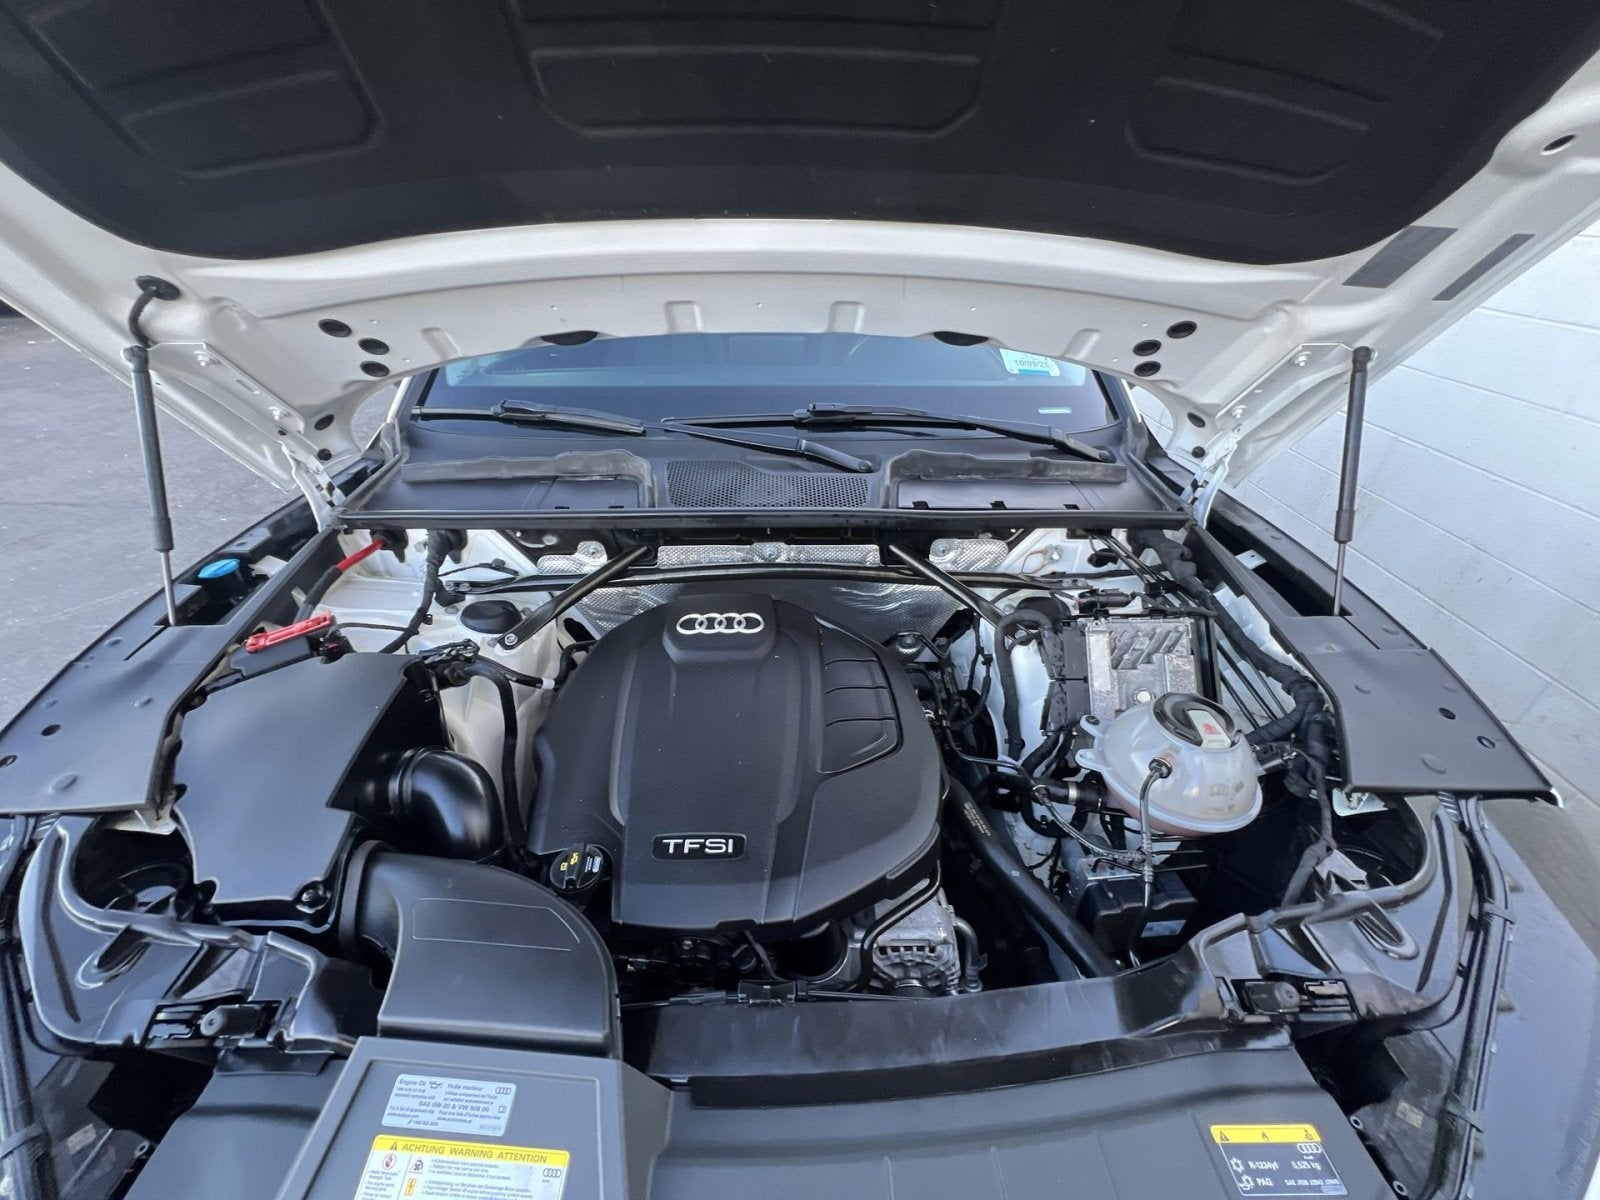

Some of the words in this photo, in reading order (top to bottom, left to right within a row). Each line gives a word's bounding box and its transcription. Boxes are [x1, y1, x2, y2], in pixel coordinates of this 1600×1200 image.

[662, 838, 734, 854] TFSI
[399, 1078, 418, 1086] Engine
[401, 1144, 445, 1155] ACHTUNG
[449, 1147, 493, 1159] WARNING
[497, 1150, 547, 1164] ATTENTION
[1311, 1161, 1322, 1171] kg
[1255, 1178, 1273, 1186] PAG
